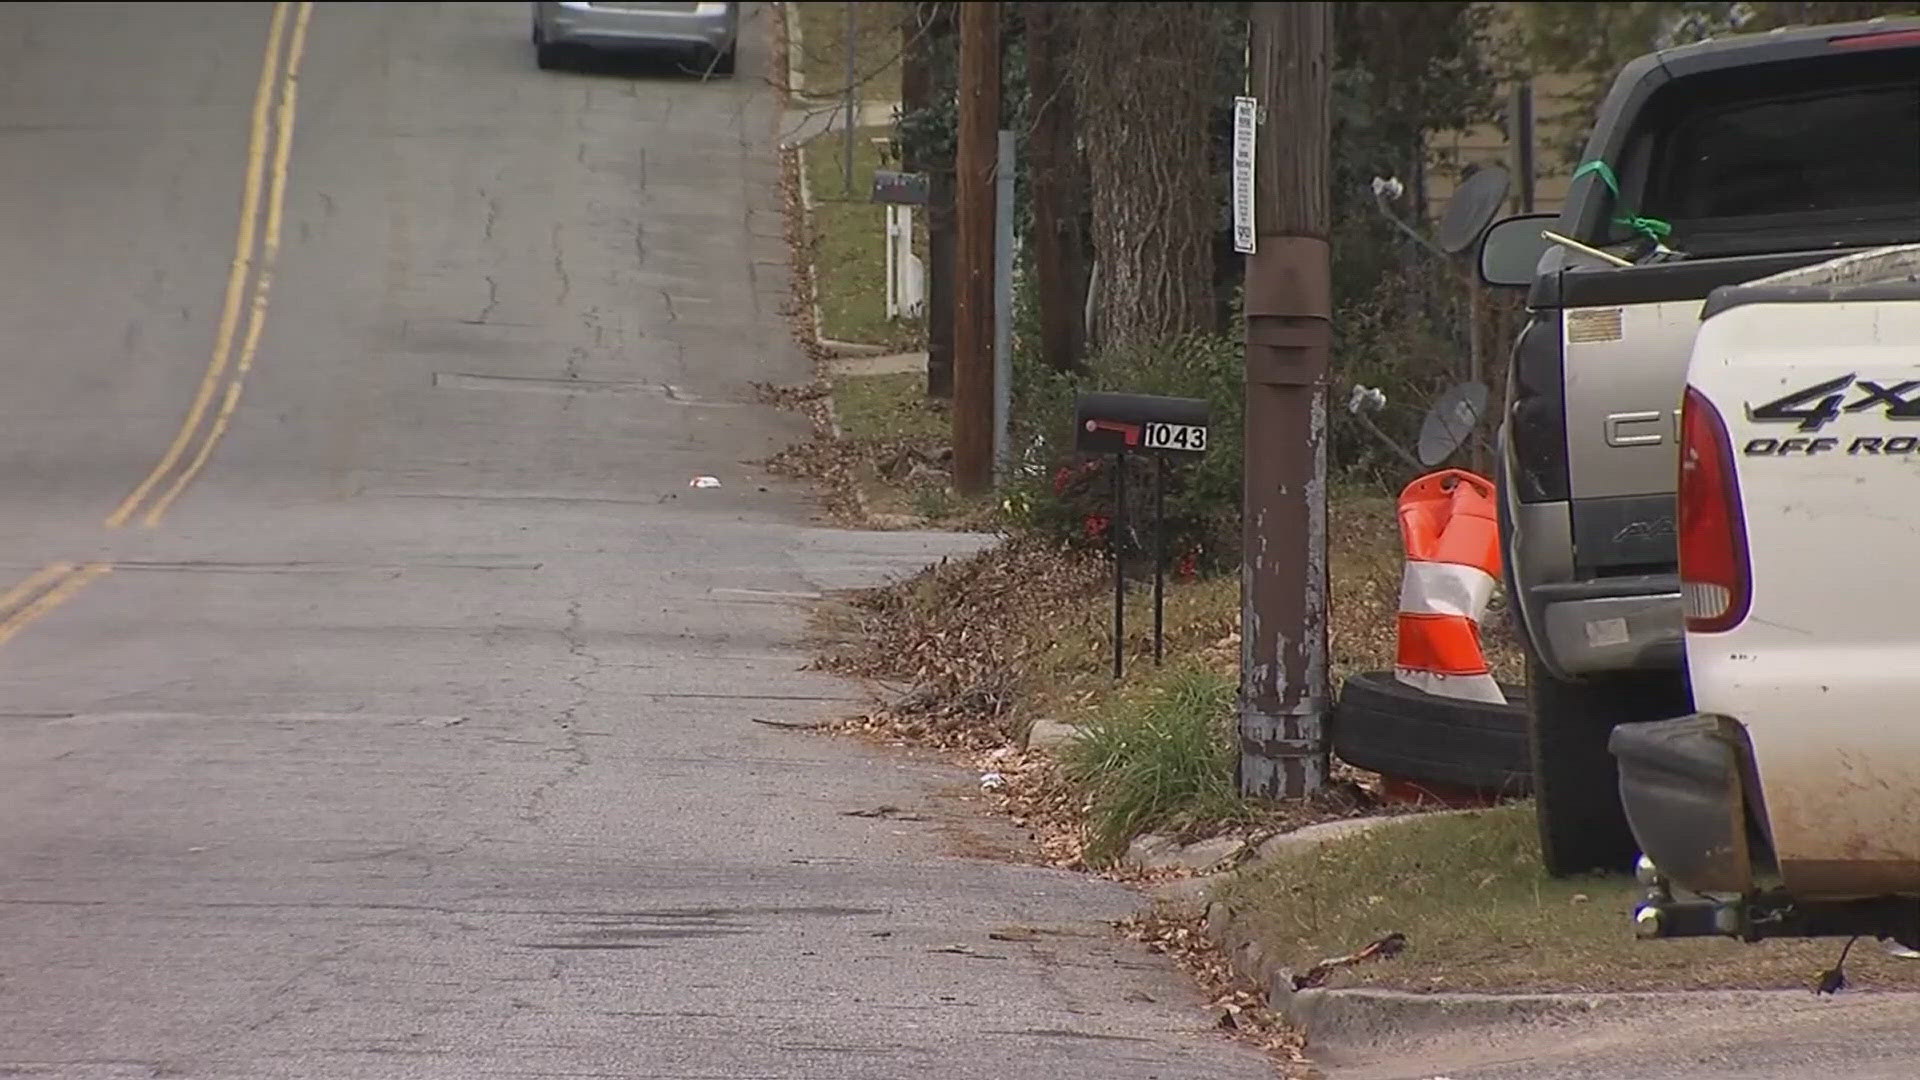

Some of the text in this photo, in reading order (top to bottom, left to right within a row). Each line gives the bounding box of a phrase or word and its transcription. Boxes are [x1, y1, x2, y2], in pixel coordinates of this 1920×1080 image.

[1146, 423, 1205, 449] 1043
[1604, 410, 1682, 448] C
[1744, 436, 1920, 456] OFF RO
